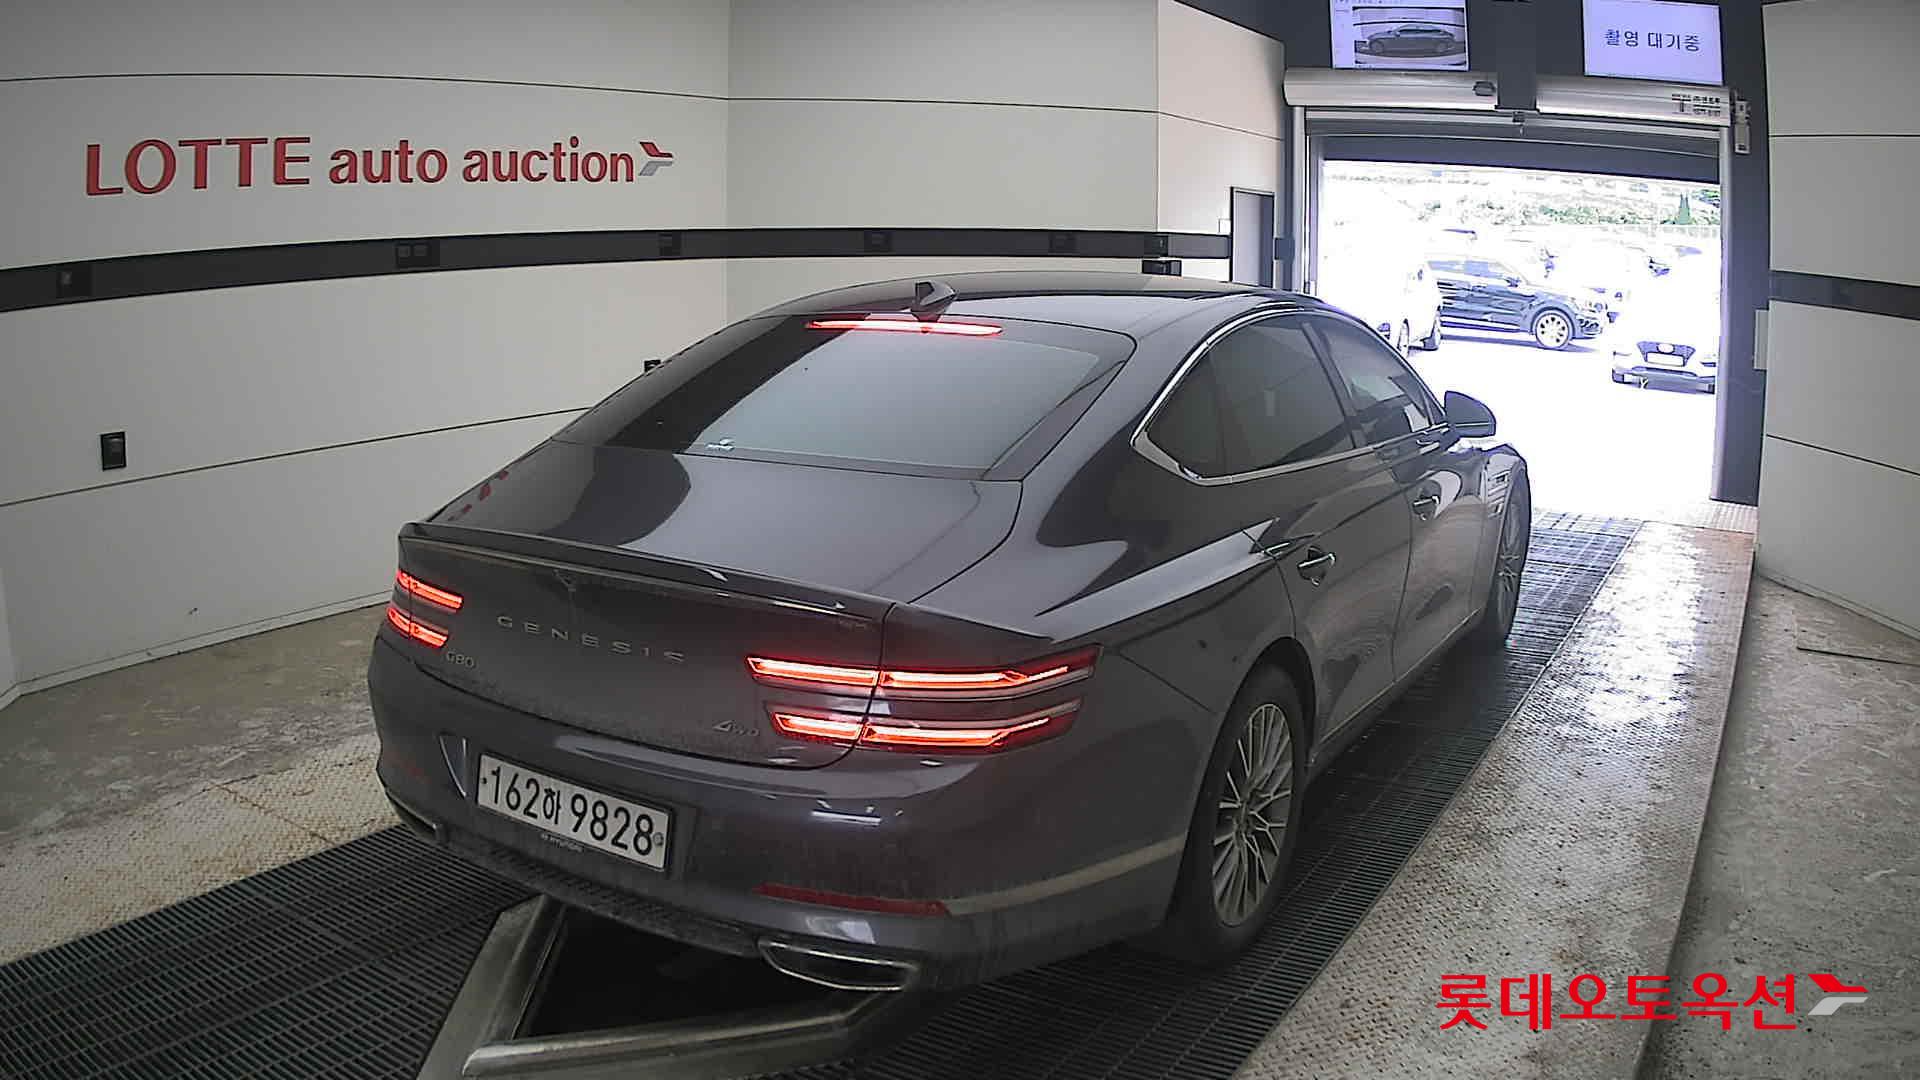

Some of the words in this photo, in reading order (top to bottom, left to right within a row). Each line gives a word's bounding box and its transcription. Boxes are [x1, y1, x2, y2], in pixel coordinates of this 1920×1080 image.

[1647, 32, 1701, 52] 대기중
[85, 136, 311, 197] LOTTE
[328, 139, 448, 184] auto
[462, 136, 635, 183] auction
[445, 650, 475, 669] G80
[497, 615, 686, 664] GENESIS
[491, 766, 562, 825] 162하
[570, 793, 654, 856] 9828
